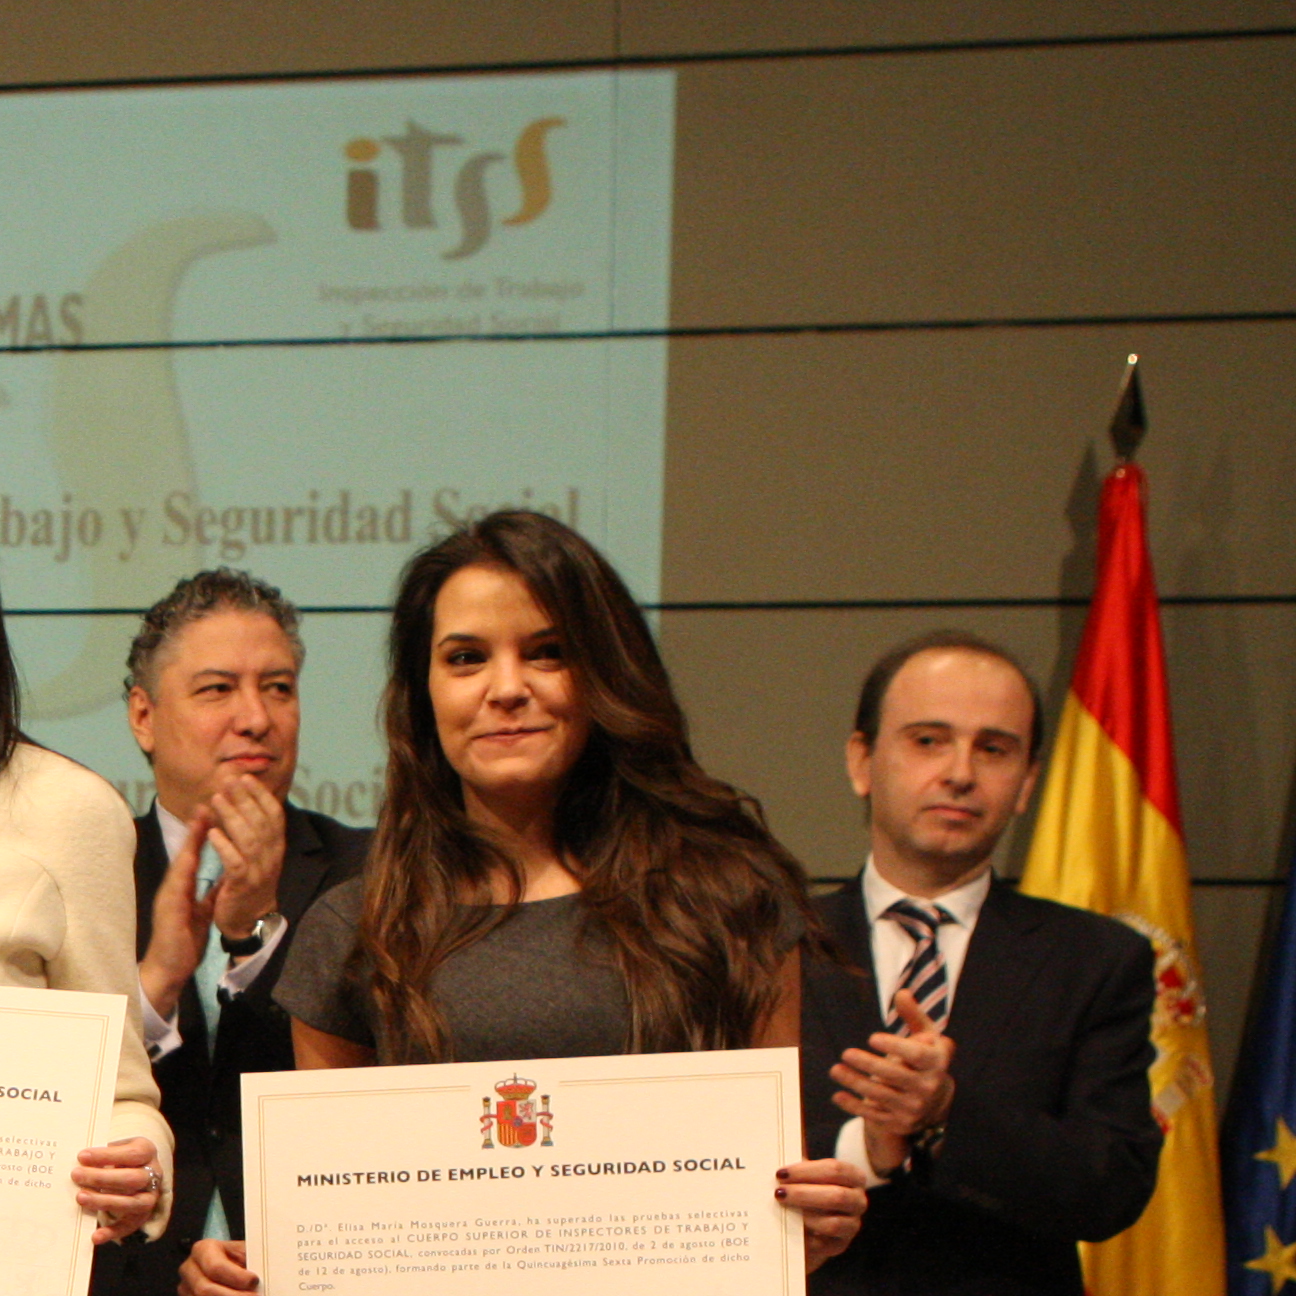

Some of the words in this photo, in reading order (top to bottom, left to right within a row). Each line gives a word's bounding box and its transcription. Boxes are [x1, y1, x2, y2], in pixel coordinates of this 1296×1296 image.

[118, 507, 145, 561] y
[162, 489, 412, 560] Seguridad
[297, 1170, 410, 1186] MINISTERIO
[417, 1169, 440, 1182] DE
[448, 1166, 524, 1181] EMPLEO
[532, 1165, 542, 1177] Y
[550, 1160, 665, 1177] SEGURIDAD
[673, 1157, 745, 1172] SOCIAL
[337, 1222, 363, 1232] Elisa
[371, 1221, 403, 1230] María
[410, 1219, 467, 1231] Mosquera
[526, 1216, 539, 1225] ha
[547, 1215, 601, 1226] superado
[609, 1213, 625, 1222] las
[632, 1212, 680, 1223] pruebas
[687, 1210, 748, 1219] selectivas
[297, 1240, 321, 1248] para
[328, 1236, 337, 1245] el
[345, 1237, 383, 1245] acceso
[390, 1235, 399, 1243] al
[406, 1232, 458, 1243] CUERPO
[465, 1230, 528, 1241] SUPERIOR
[535, 1229, 551, 1239] DE
[558, 1225, 646, 1238] INSPECTORES
[653, 1225, 669, 1234] DE
[676, 1222, 735, 1235] TRABAJO
[742, 1222, 747, 1230] Y
[297, 1250, 362, 1261] SEGURIDAD
[418, 1248, 477, 1257] convocadas
[482, 1248, 500, 1257] por
[506, 1244, 539, 1254] Orden
[632, 1241, 644, 1251] de
[650, 1240, 655, 1249] 2
[662, 1240, 674, 1249] de
[679, 1241, 715, 1251] agosto
[720, 1237, 748, 1248] (BOE
[298, 1267, 309, 1276] de
[316, 1266, 327, 1275] 12
[332, 1266, 344, 1275] de
[395, 1263, 445, 1273] formando
[451, 1264, 479, 1273] parte
[485, 1262, 497, 1270] de
[502, 1261, 511, 1269] la
[516, 1258, 596, 1271] Quincuagésima
[602, 1256, 631, 1266] Sexta
[637, 1254, 695, 1265] Promoción
[701, 1254, 713, 1263] de
[719, 1253, 749, 1262] dicho
